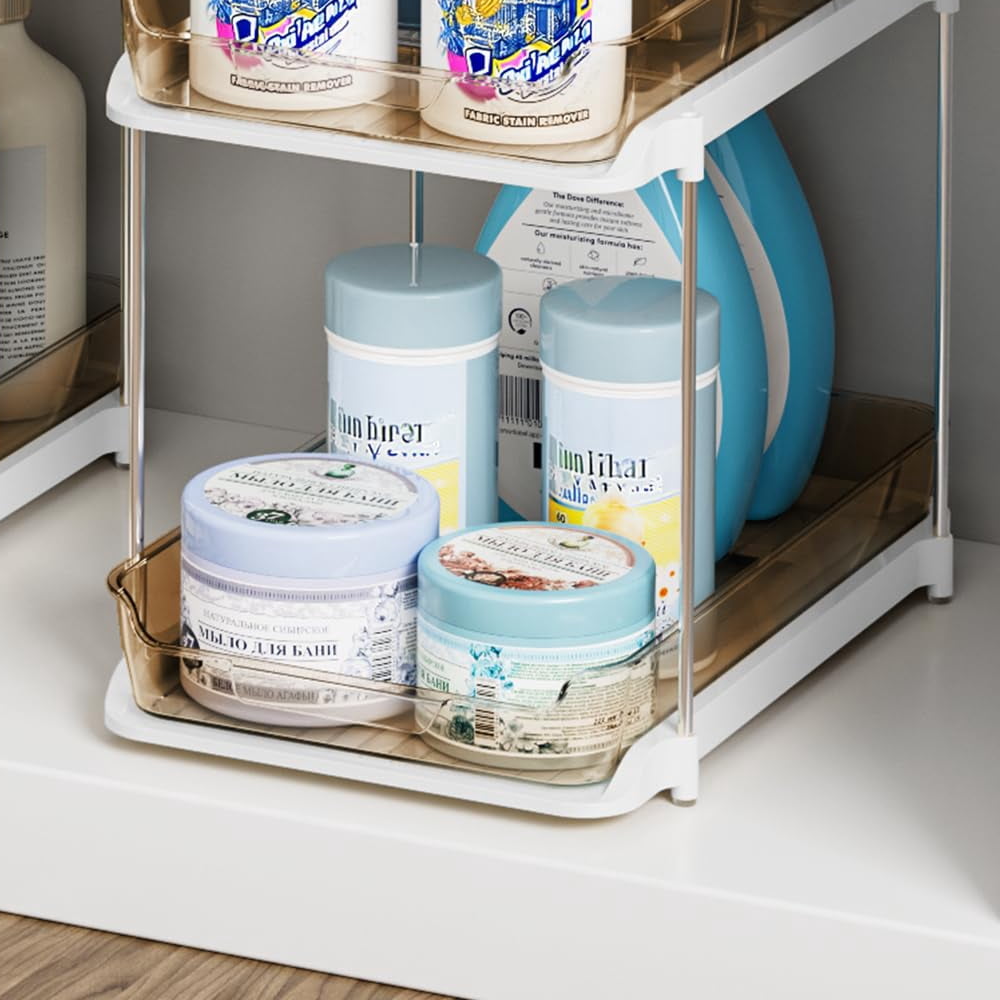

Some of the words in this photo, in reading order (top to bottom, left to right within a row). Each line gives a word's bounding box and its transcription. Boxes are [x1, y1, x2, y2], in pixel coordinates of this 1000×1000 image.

[303, 74, 353, 93] REMOVER
[464, 108, 501, 126] FABRIC
[502, 115, 537, 127] STAIN
[538, 109, 590, 127] REMOVER
[553, 191, 565, 200] The
[567, 193, 584, 202] Dove
[586, 195, 625, 208] Difference:
[534, 229, 548, 238] Our
[549, 231, 595, 246] moisturizing
[597, 237, 626, 249] formula
[627, 240, 643, 251] has:
[198, 624, 248, 651] МЫЛО
[251, 640, 287, 657] ДЛЯ
[292, 640, 337, 657] БАНИ
